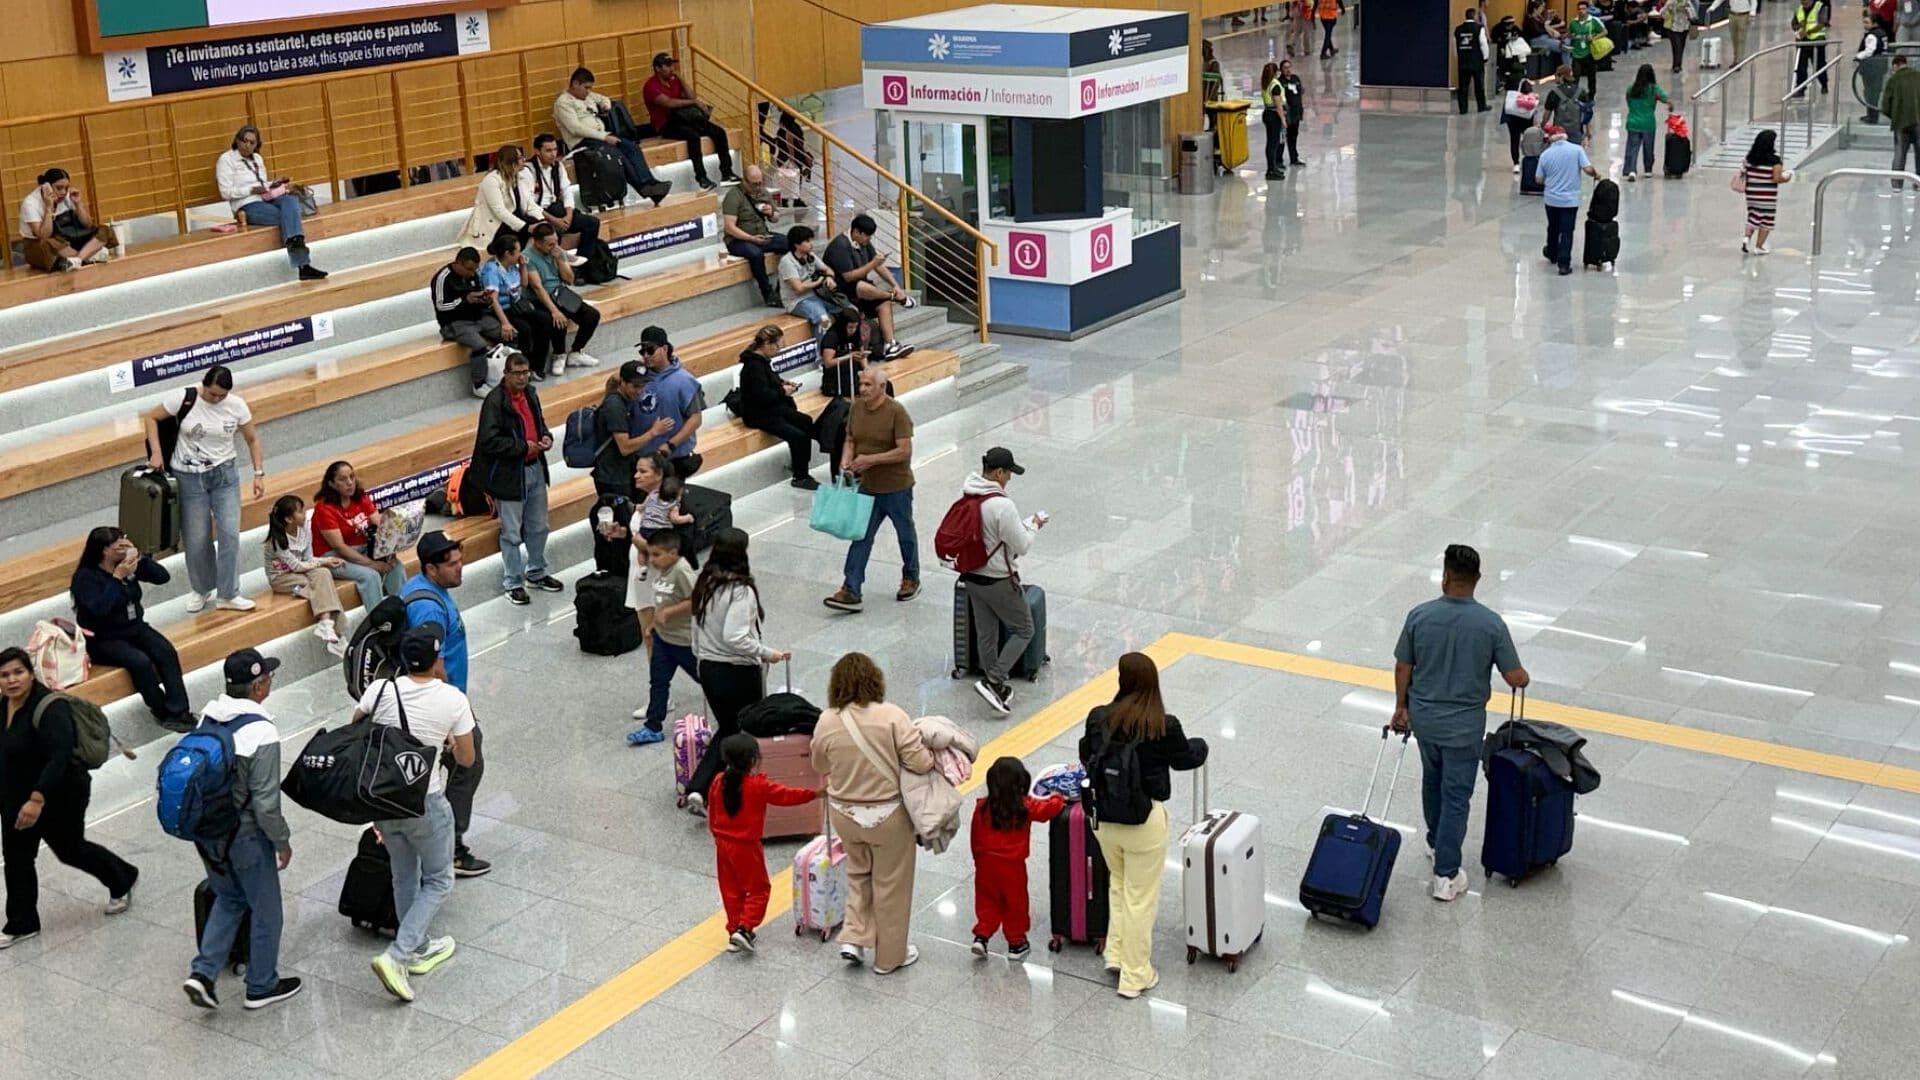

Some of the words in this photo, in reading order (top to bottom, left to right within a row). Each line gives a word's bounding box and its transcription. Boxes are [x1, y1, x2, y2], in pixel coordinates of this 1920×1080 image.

[166, 48, 185, 68] ¡Te
[186, 45, 244, 63] invitamos
[247, 43, 254, 54] a
[256, 34, 309, 54] sentarte!,
[310, 32, 333, 48] este
[334, 27, 373, 48] espacio
[374, 28, 386, 40] es
[388, 24, 410, 42] para
[411, 19, 442, 35] todos.
[192, 66, 209, 81] We
[210, 63, 239, 80] invite
[239, 63, 258, 80] you
[258, 59, 269, 74] to
[270, 58, 290, 72] take
[291, 57, 297, 69] a
[298, 53, 320, 68] seat,
[320, 51, 338, 66] this
[338, 49, 364, 66] space
[364, 46, 373, 60] is
[372, 44, 385, 58] for
[386, 41, 425, 58] everyone
[910, 84, 981, 102] Información
[991, 88, 1053, 106] Information
